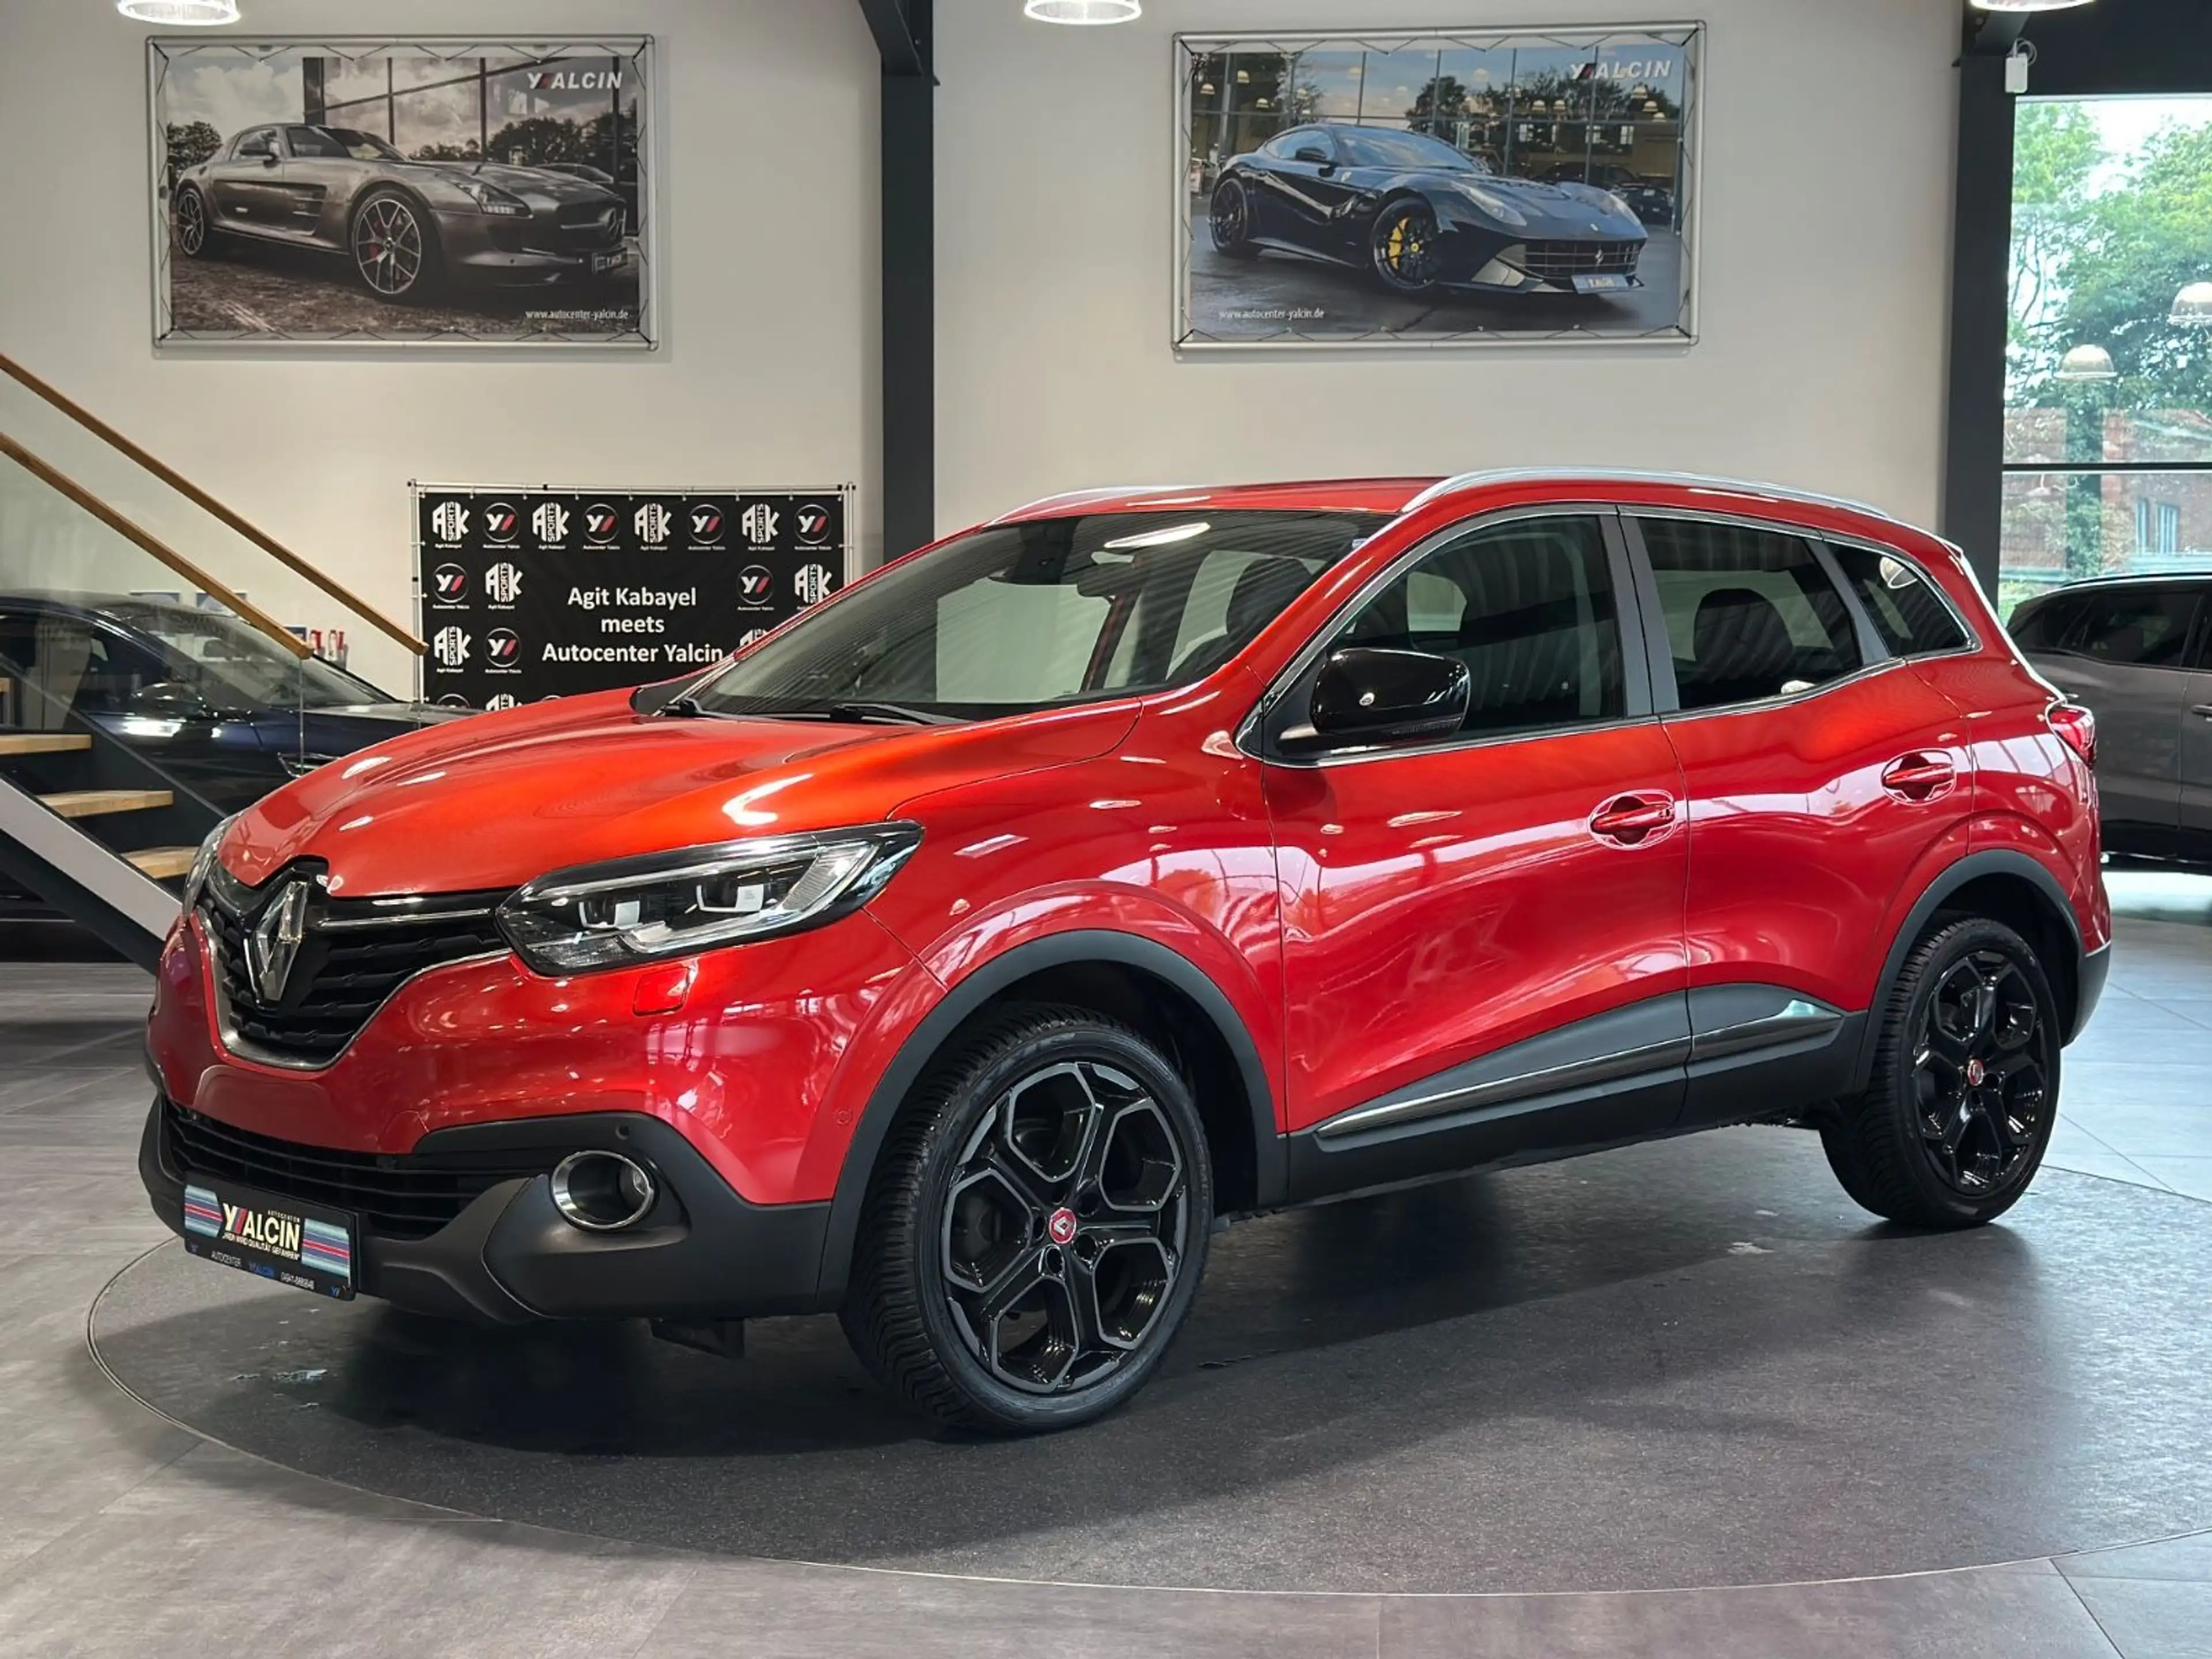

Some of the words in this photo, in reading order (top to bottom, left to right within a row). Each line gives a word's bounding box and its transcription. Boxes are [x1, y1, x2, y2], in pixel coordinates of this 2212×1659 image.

[525, 308, 628, 321] www.autocenter-yalcin.de
[567, 587, 610, 609] Agit
[616, 586, 696, 611] Kabayel
[601, 616, 665, 633] meets
[542, 643, 659, 662] Autocenter
[664, 643, 722, 662] Yalcin
[222, 1202, 300, 1252] YALCIN
